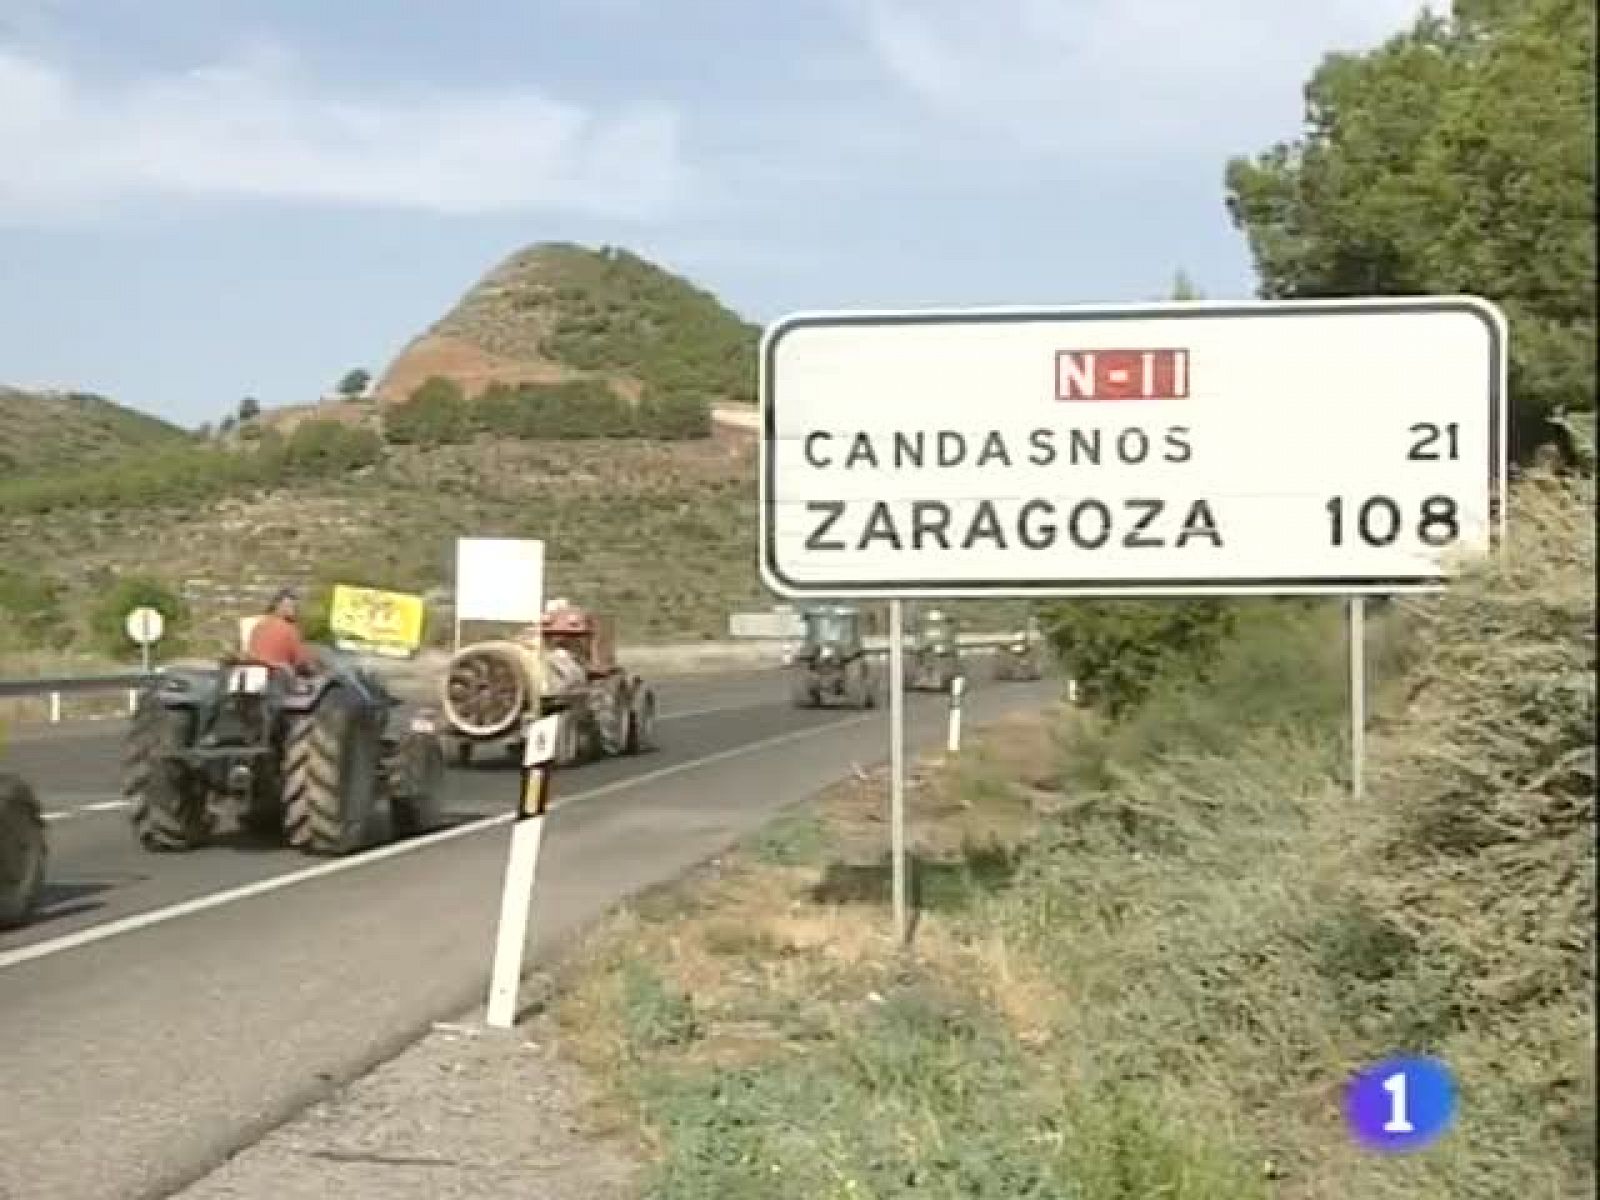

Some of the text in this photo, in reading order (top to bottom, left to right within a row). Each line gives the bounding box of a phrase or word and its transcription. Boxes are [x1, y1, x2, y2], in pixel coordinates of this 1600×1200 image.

[804, 422, 1460, 469] CANDASNOS 21
[804, 495, 1460, 551] ZARAGOZA 108
